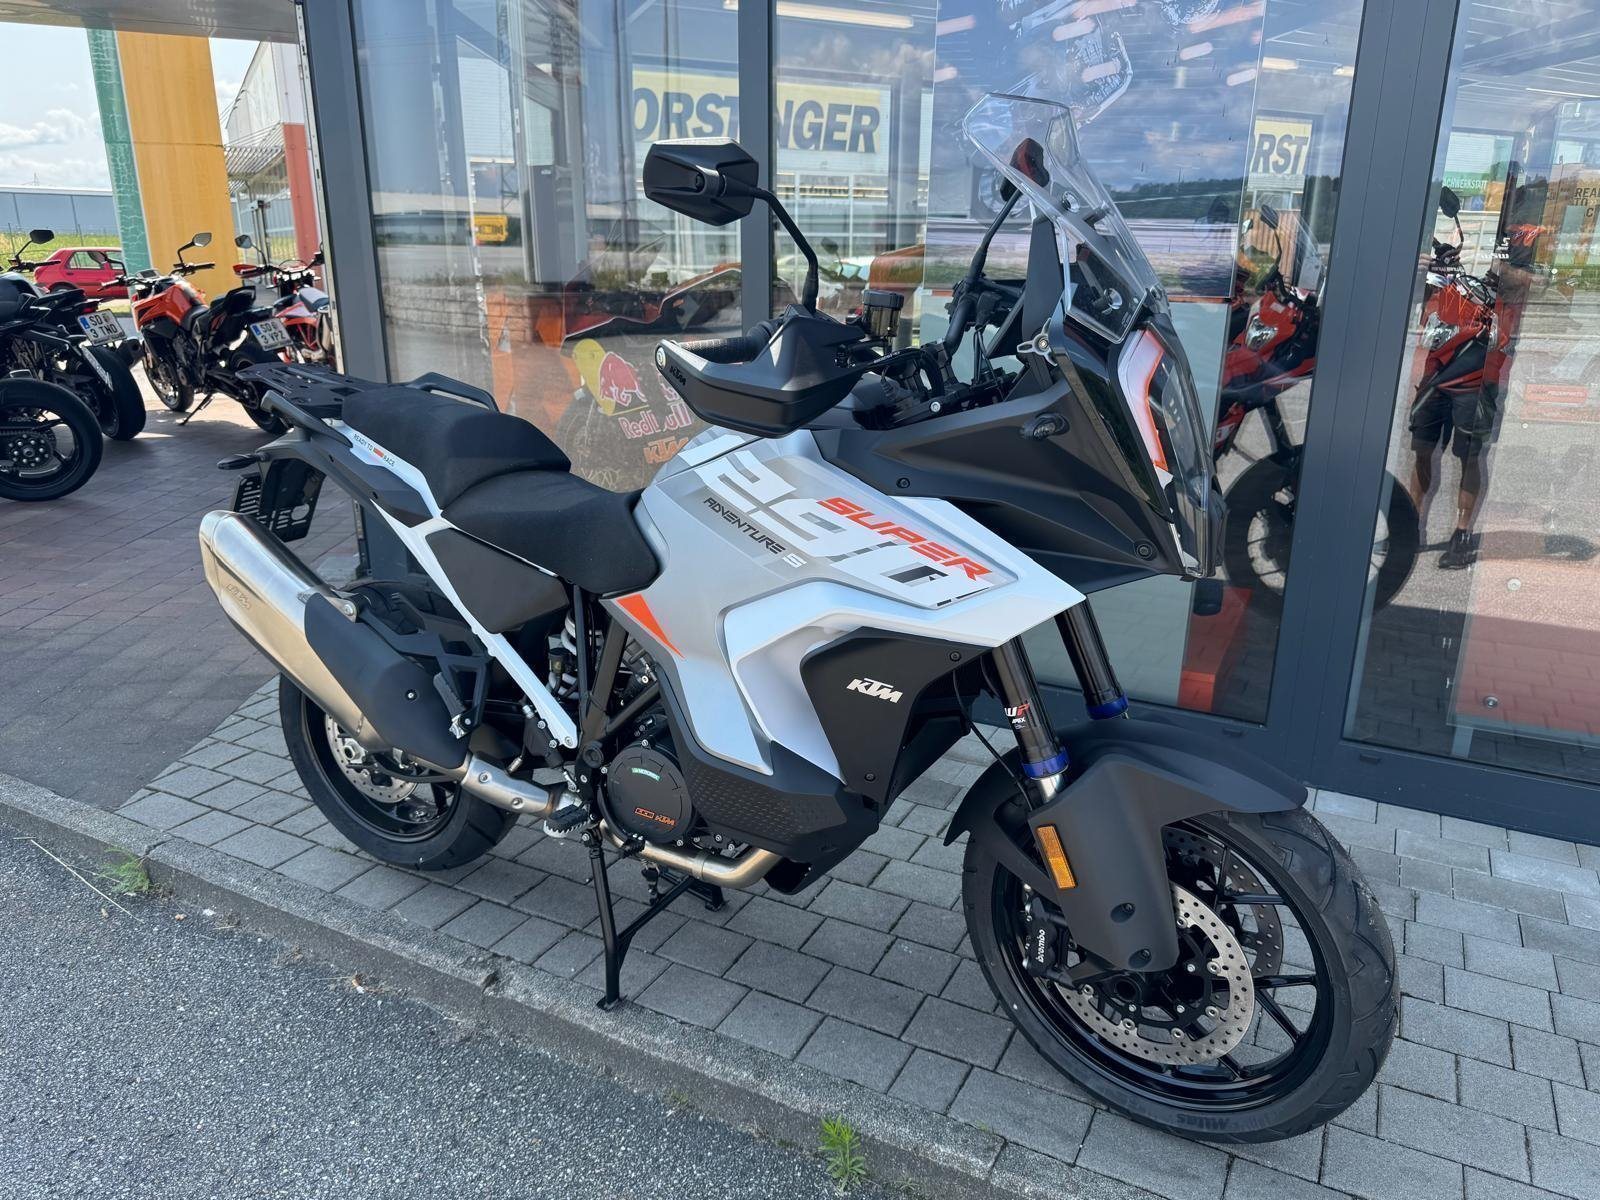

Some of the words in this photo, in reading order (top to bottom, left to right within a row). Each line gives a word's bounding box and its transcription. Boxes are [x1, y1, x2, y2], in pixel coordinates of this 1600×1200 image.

[1252, 133, 1309, 175] RST
[90, 328, 99, 338] 3
[670, 365, 687, 386] KTM
[353, 433, 367, 447] READY
[383, 455, 396, 467] RACE
[703, 497, 787, 555] ADVENTURE
[781, 553, 808, 569] S
[816, 497, 993, 581] SUPER
[846, 677, 903, 704] KTM
[1004, 703, 1030, 717] WP
[1035, 929, 1046, 964] brembo
